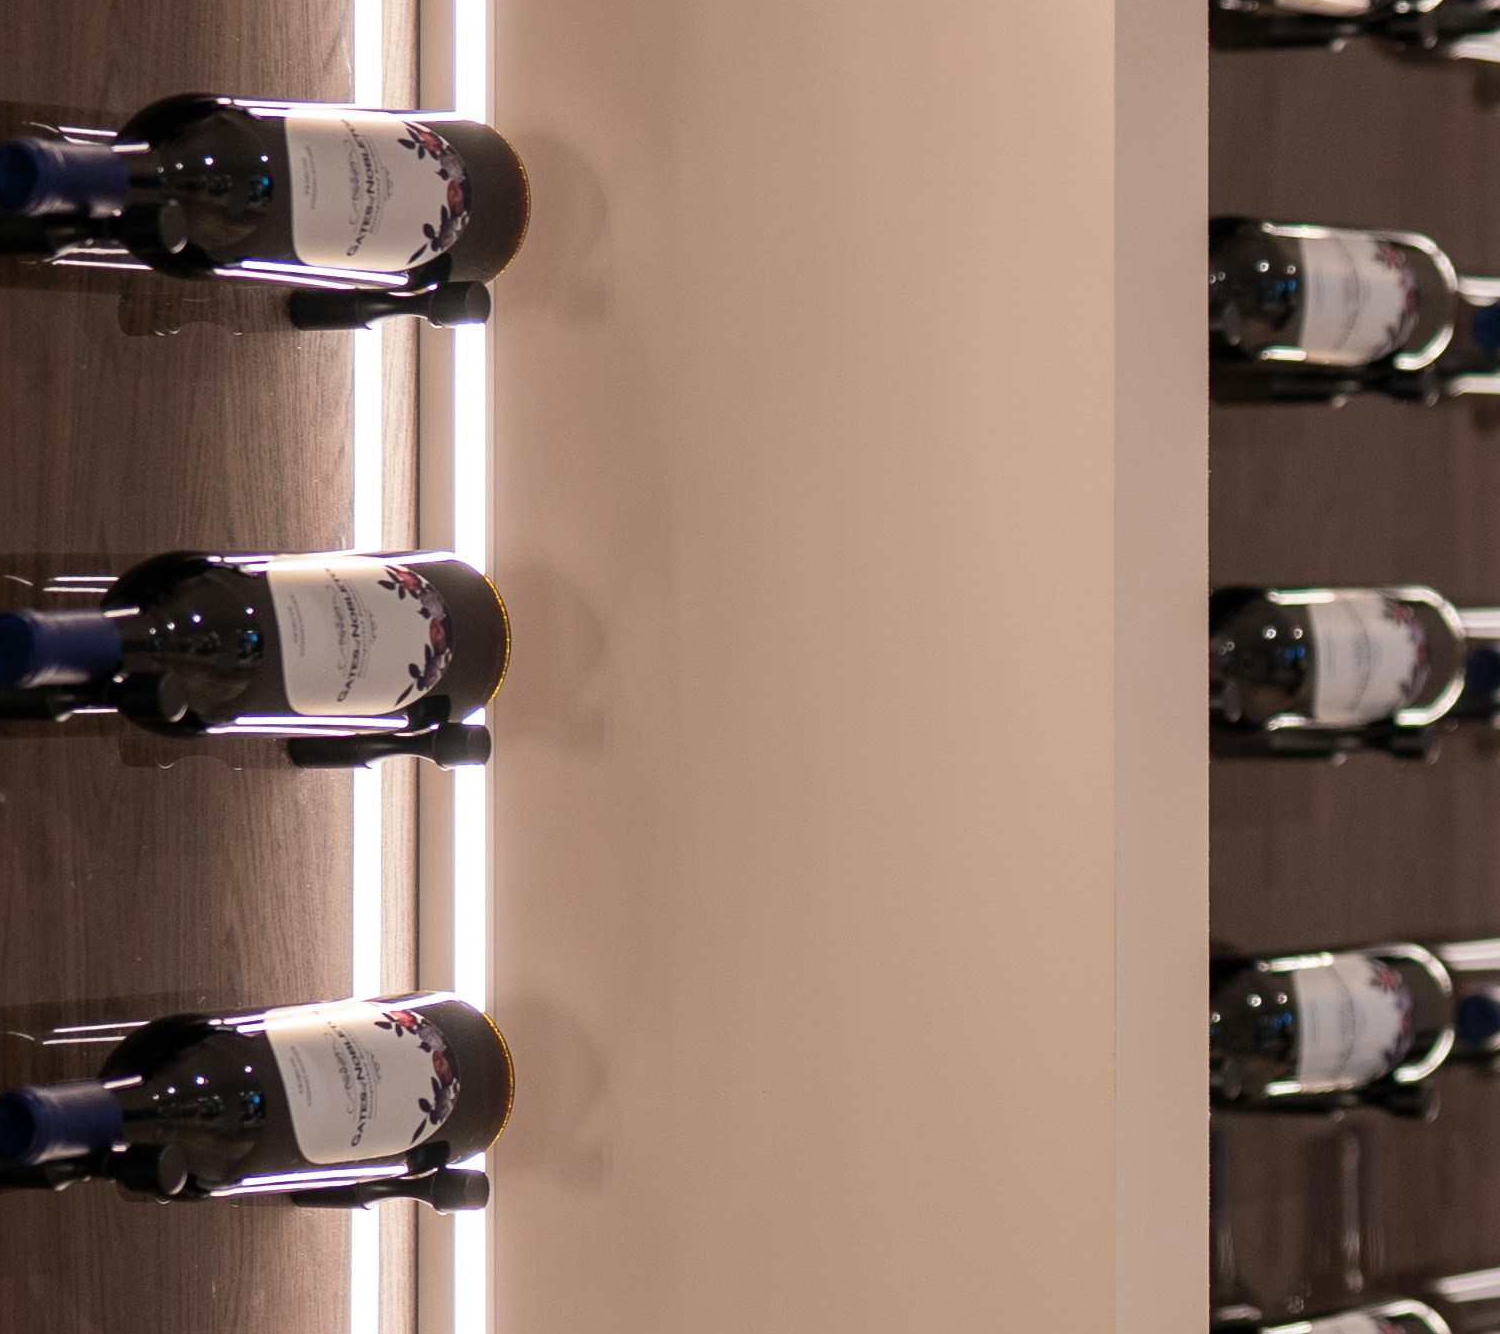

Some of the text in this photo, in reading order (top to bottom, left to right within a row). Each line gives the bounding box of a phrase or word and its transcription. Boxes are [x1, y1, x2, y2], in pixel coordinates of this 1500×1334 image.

[346, 206, 374, 257] GATES
[337, 649, 360, 702] GATES
[351, 1091, 367, 1147] GATES
